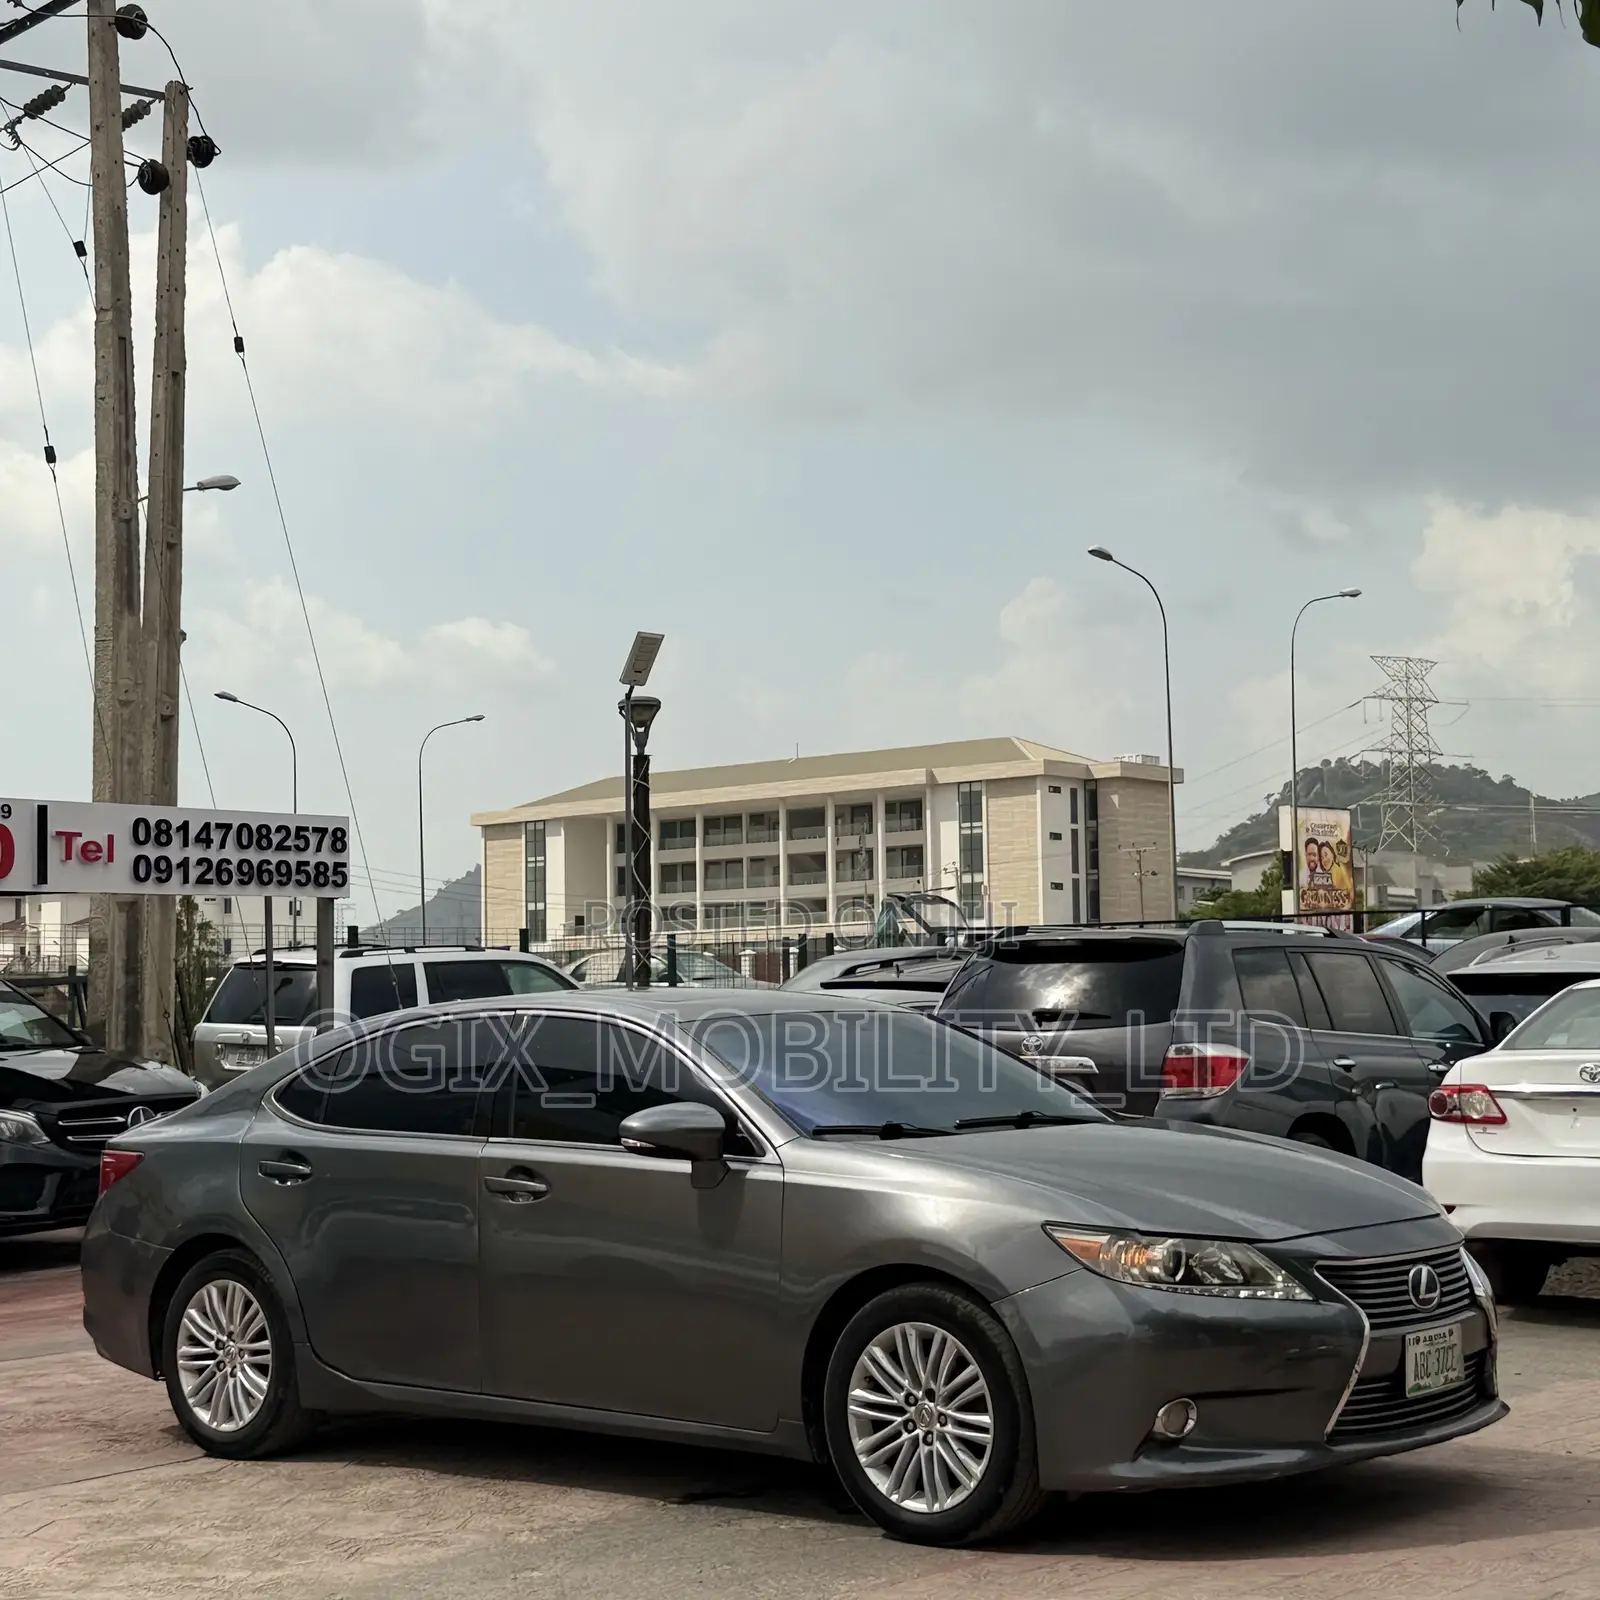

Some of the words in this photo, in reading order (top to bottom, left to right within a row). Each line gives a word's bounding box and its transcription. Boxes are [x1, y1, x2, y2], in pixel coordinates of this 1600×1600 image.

[54, 830, 115, 864] Tel
[132, 817, 348, 854] 08147082578
[132, 854, 348, 889] 09126969585
